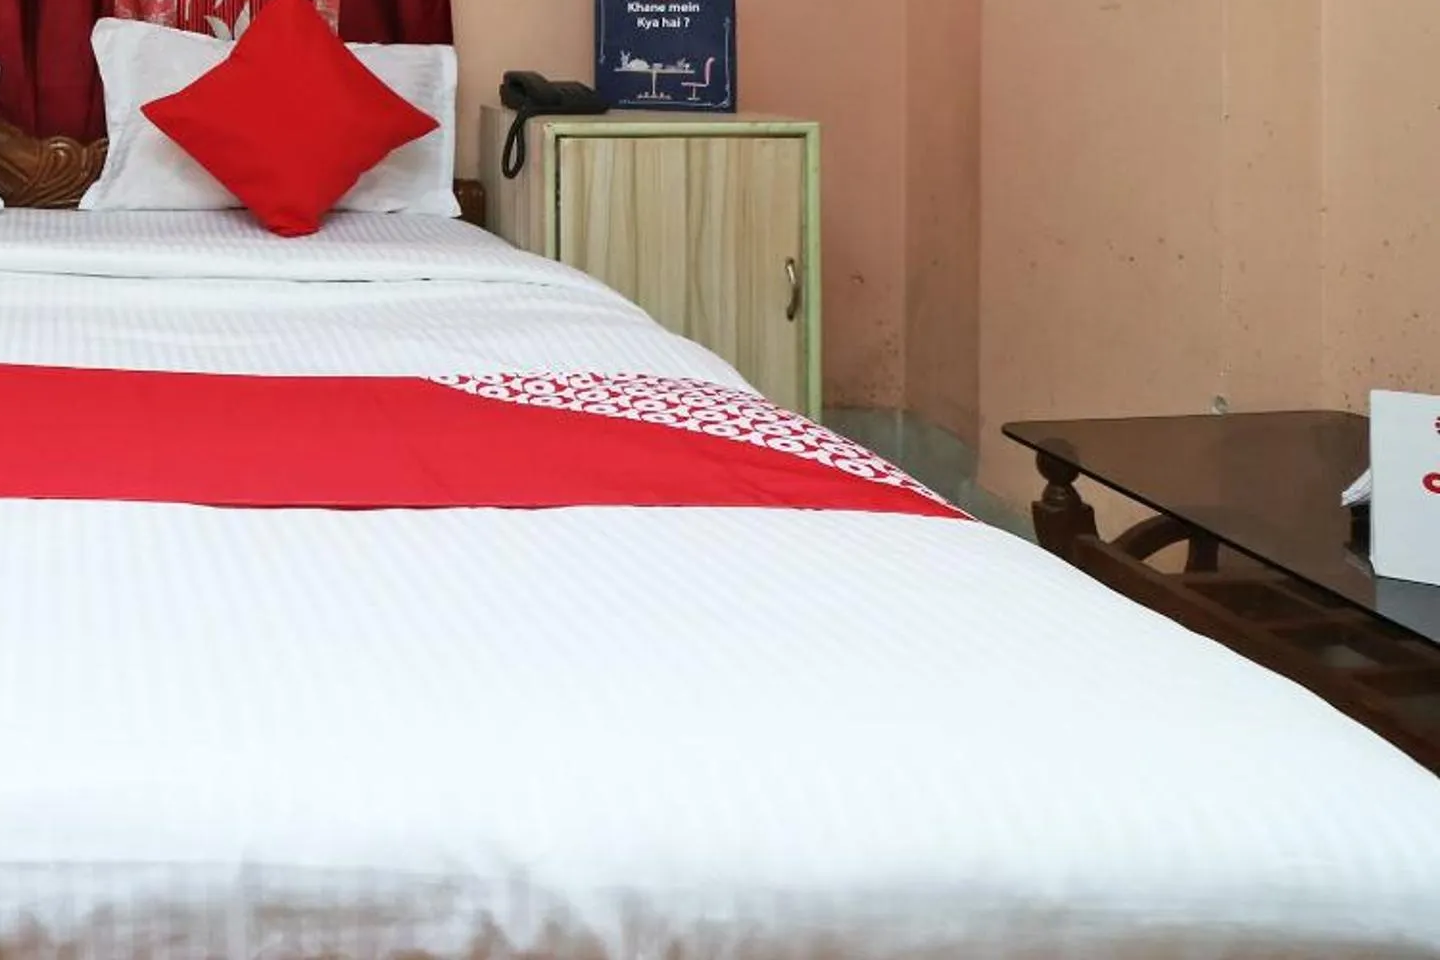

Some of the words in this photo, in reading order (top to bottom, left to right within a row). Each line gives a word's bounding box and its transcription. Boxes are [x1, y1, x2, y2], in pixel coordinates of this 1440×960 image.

[627, 2, 666, 13] Khane
[668, 1, 700, 13] mein
[636, 17, 659, 30] Kya
[662, 17, 680, 28] hai
